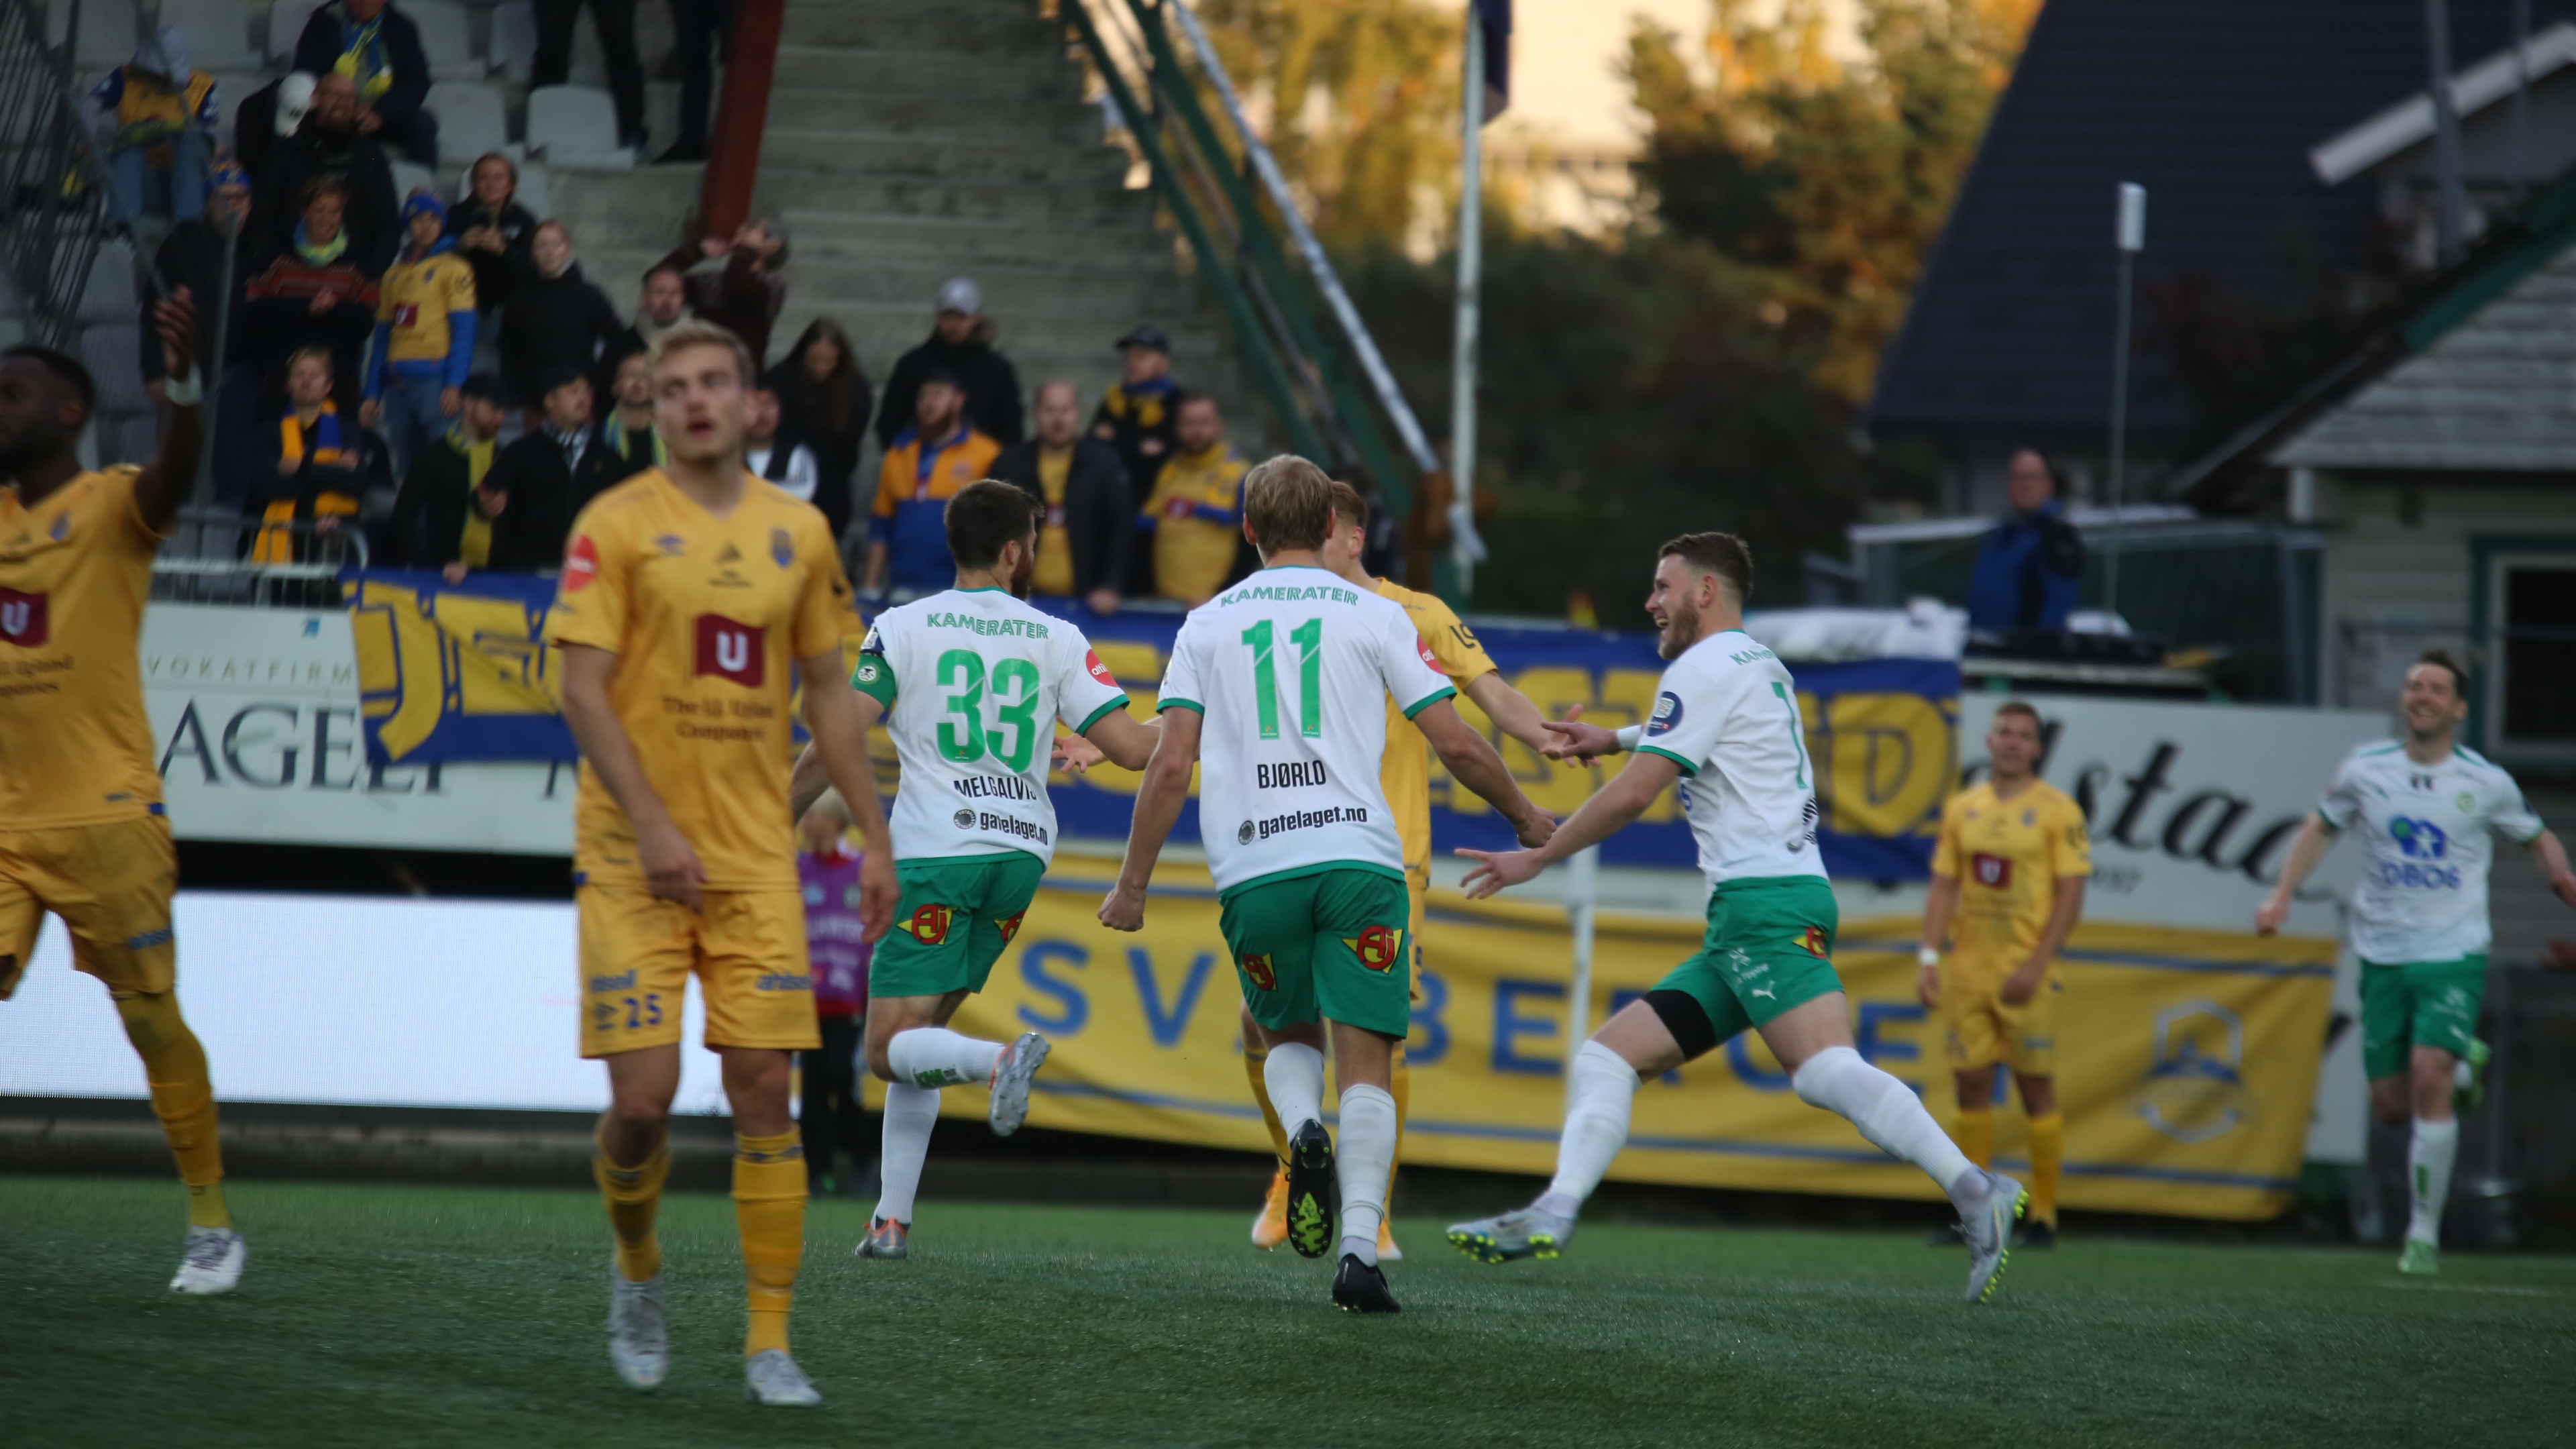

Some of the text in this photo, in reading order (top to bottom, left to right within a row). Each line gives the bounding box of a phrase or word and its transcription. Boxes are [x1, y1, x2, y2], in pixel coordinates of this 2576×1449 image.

[1221, 586, 1359, 608] KAMERATER
[928, 612, 1049, 639] KAMERATER
[716, 630, 749, 673] U
[1241, 617, 1323, 740] 11
[936, 649, 1040, 775] 33
[1257, 759, 1327, 789] BJØRLO
[1258, 806, 1368, 840] gatelaget.no
